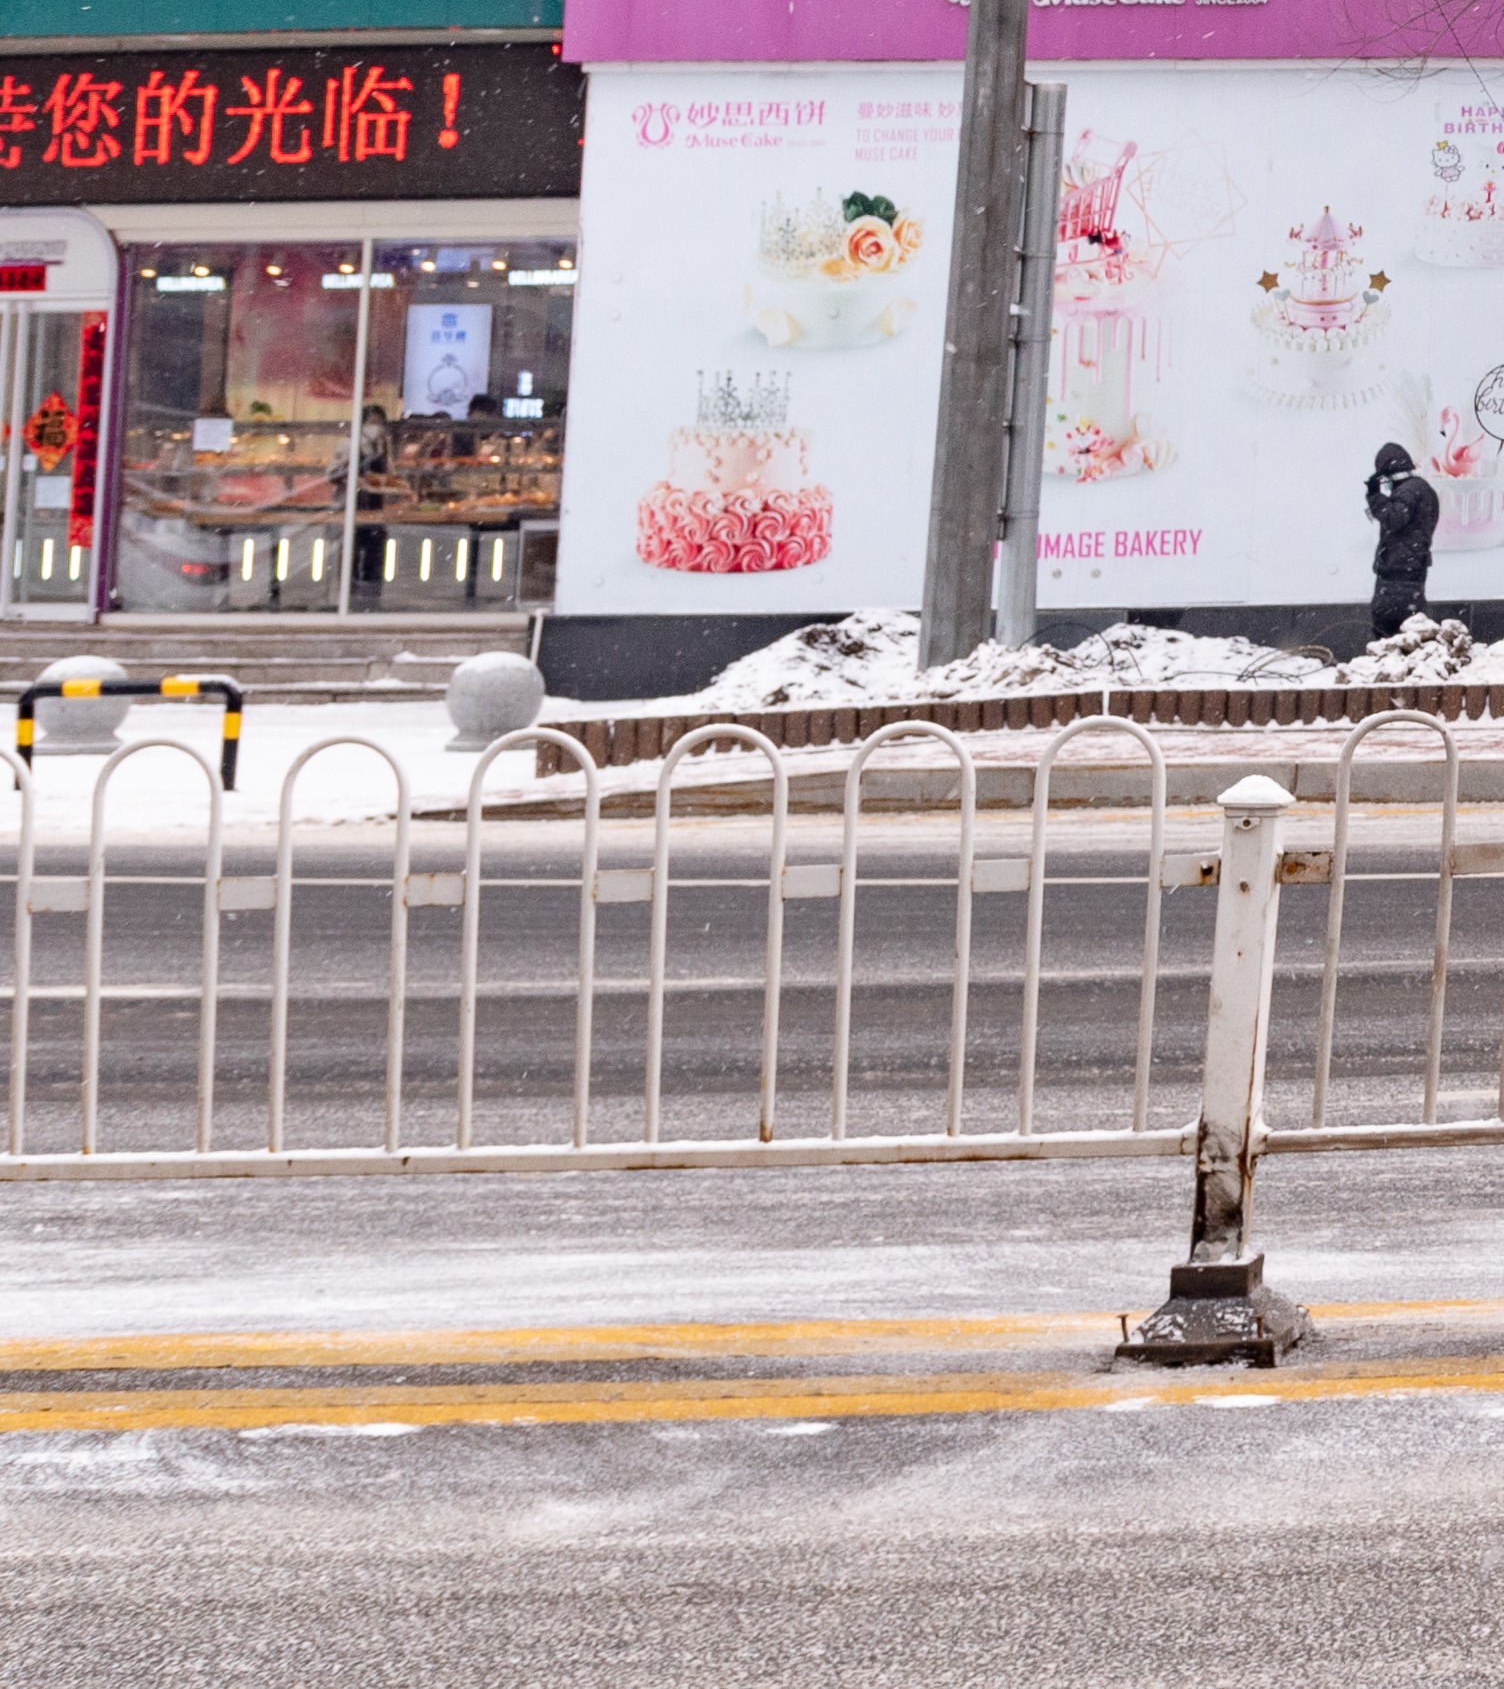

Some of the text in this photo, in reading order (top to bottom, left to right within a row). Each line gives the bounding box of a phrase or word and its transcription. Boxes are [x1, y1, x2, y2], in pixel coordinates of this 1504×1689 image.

[686, 100, 827, 129] 妙思西饼
[1114, 529, 1203, 557] BAKERY
